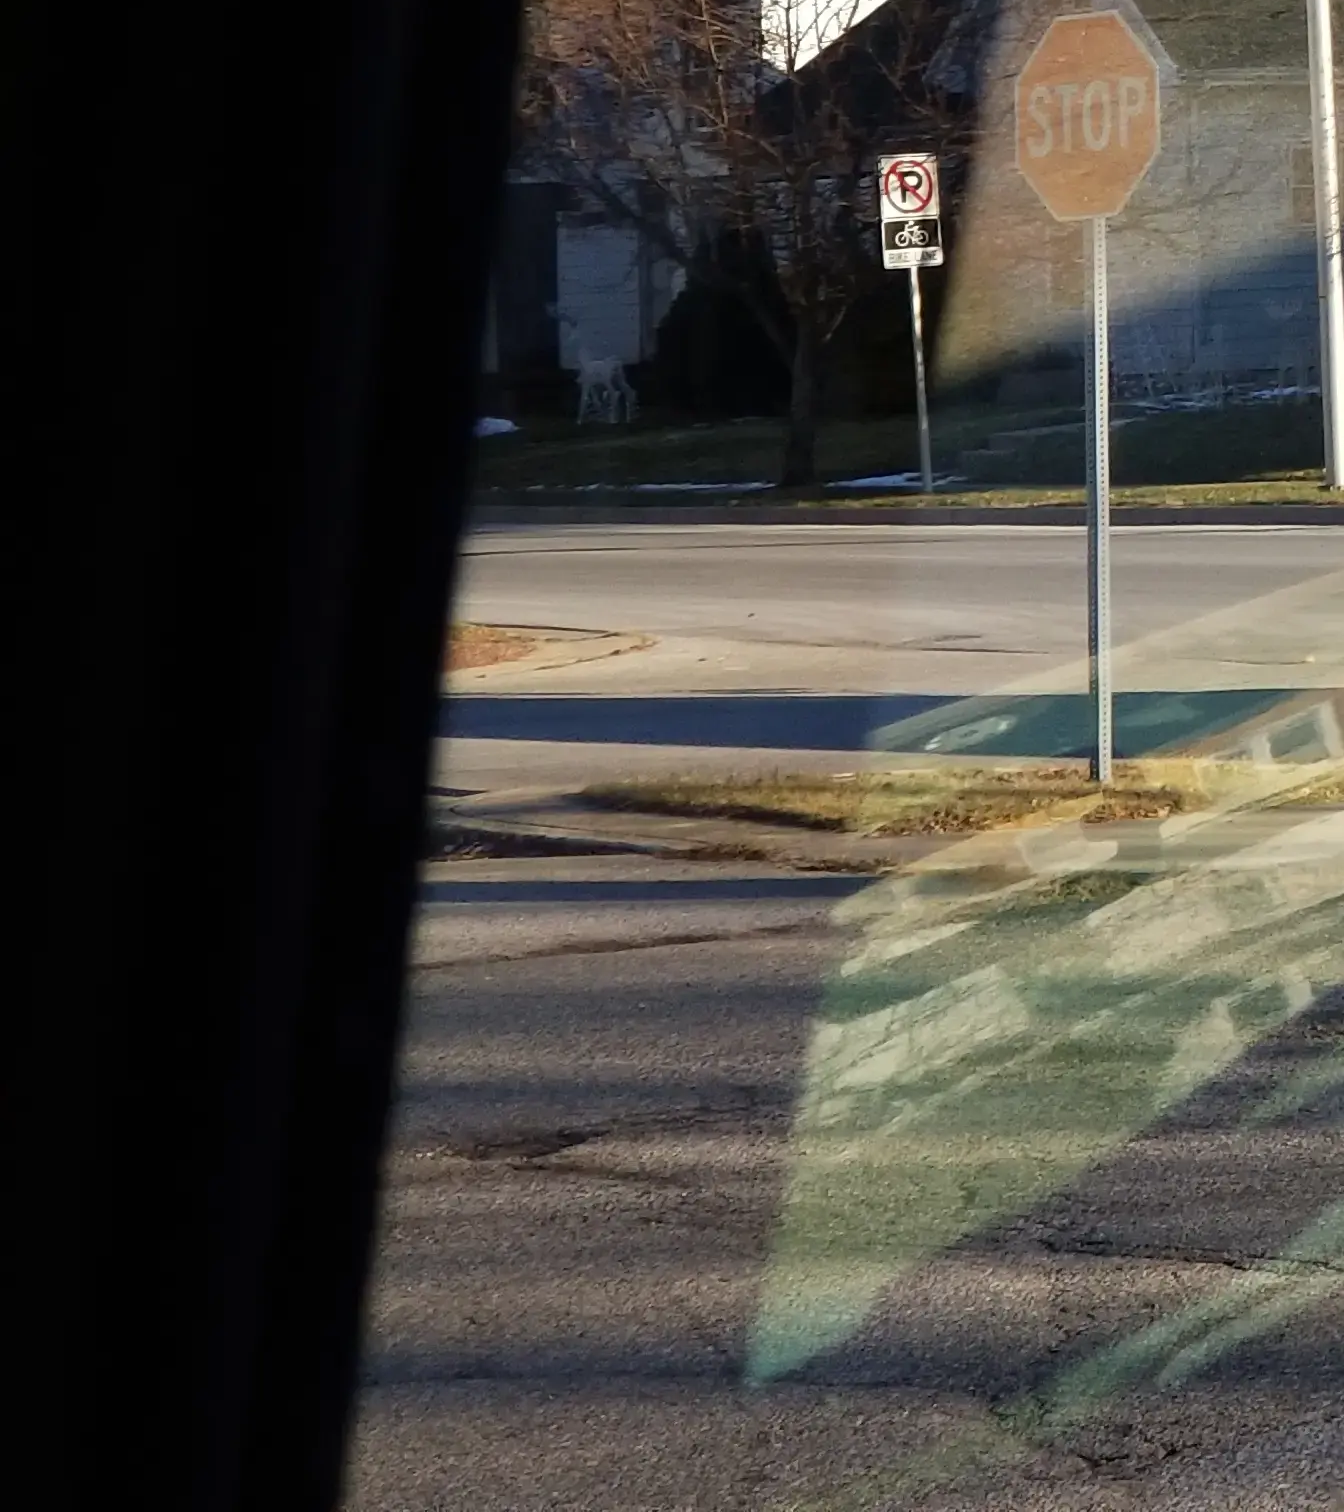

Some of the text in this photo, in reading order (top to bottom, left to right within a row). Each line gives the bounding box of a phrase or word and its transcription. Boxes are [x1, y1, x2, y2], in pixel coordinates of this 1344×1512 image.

[1028, 77, 1146, 157] STOP
[896, 170, 923, 203] P
[888, 249, 938, 263] BIKE LANE
